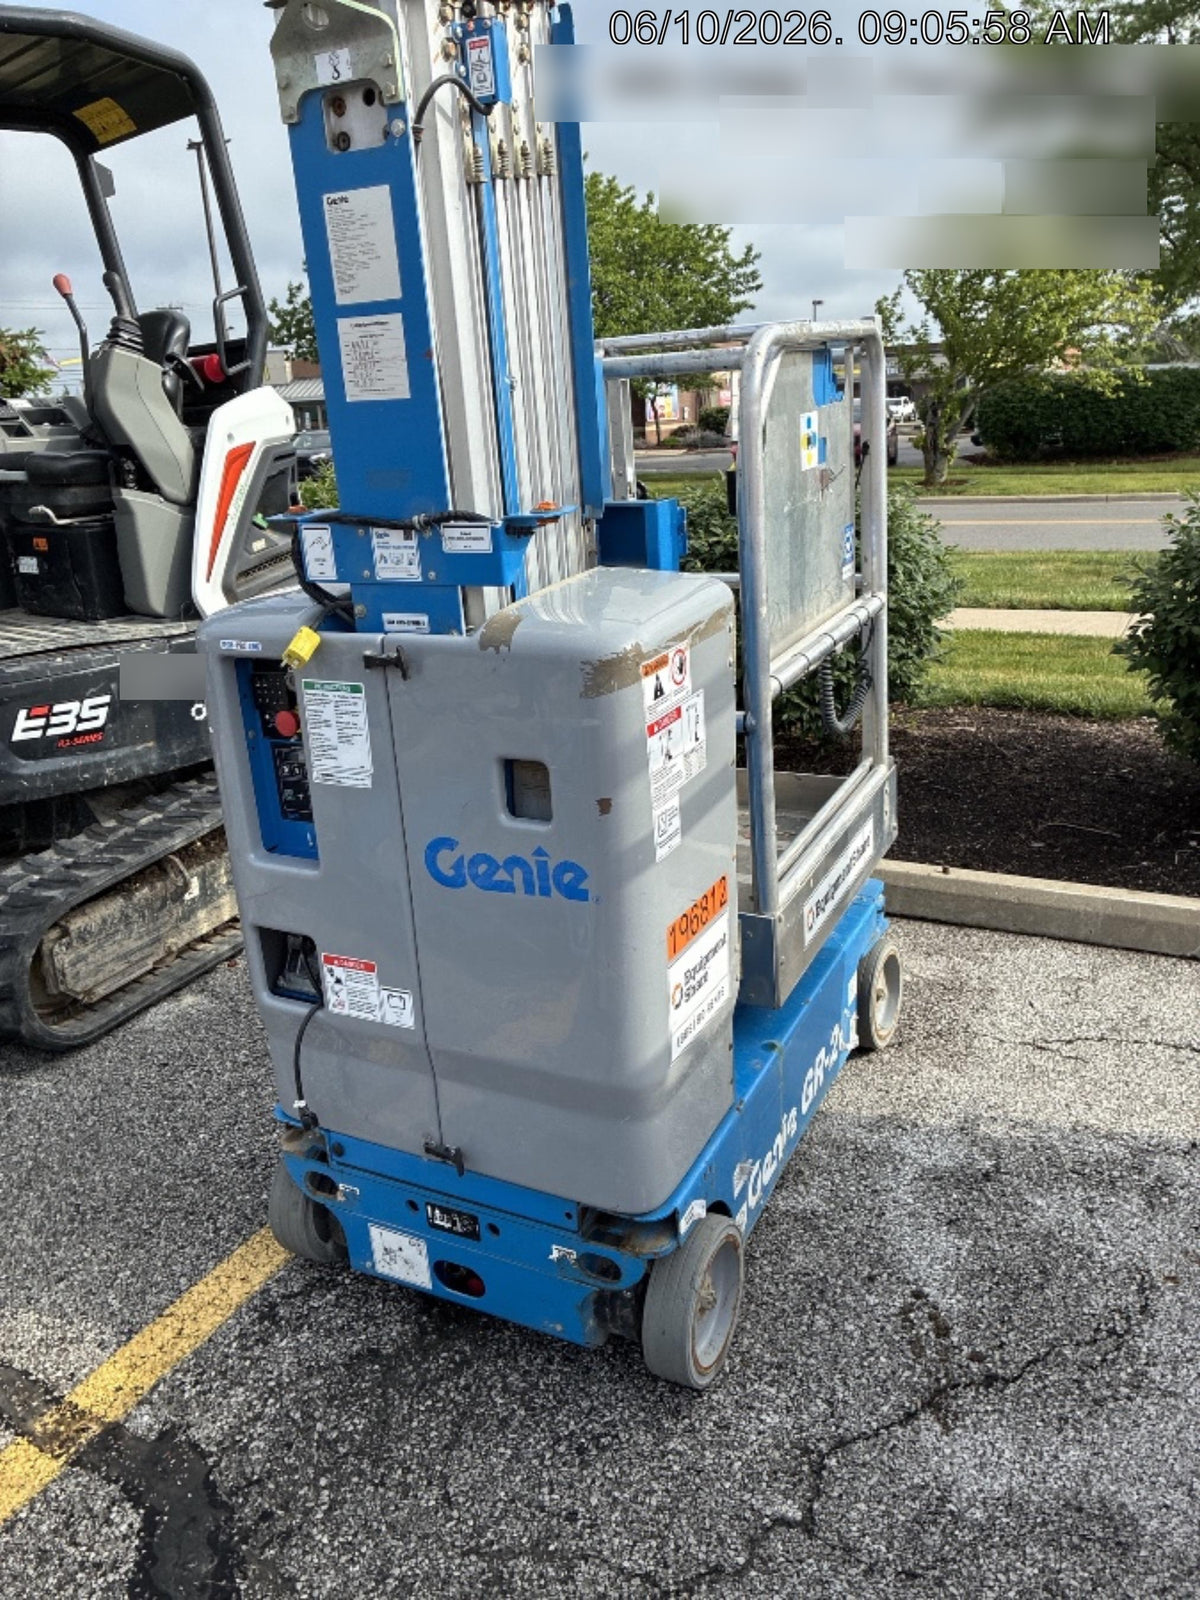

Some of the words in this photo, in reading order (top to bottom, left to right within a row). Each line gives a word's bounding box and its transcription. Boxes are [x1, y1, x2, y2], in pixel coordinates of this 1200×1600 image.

[10, 694, 112, 742] E35
[424, 836, 590, 902] Genie
[669, 875, 727, 955] 196812
[684, 942, 727, 984] Equipment
[684, 970, 709, 1003] Share
